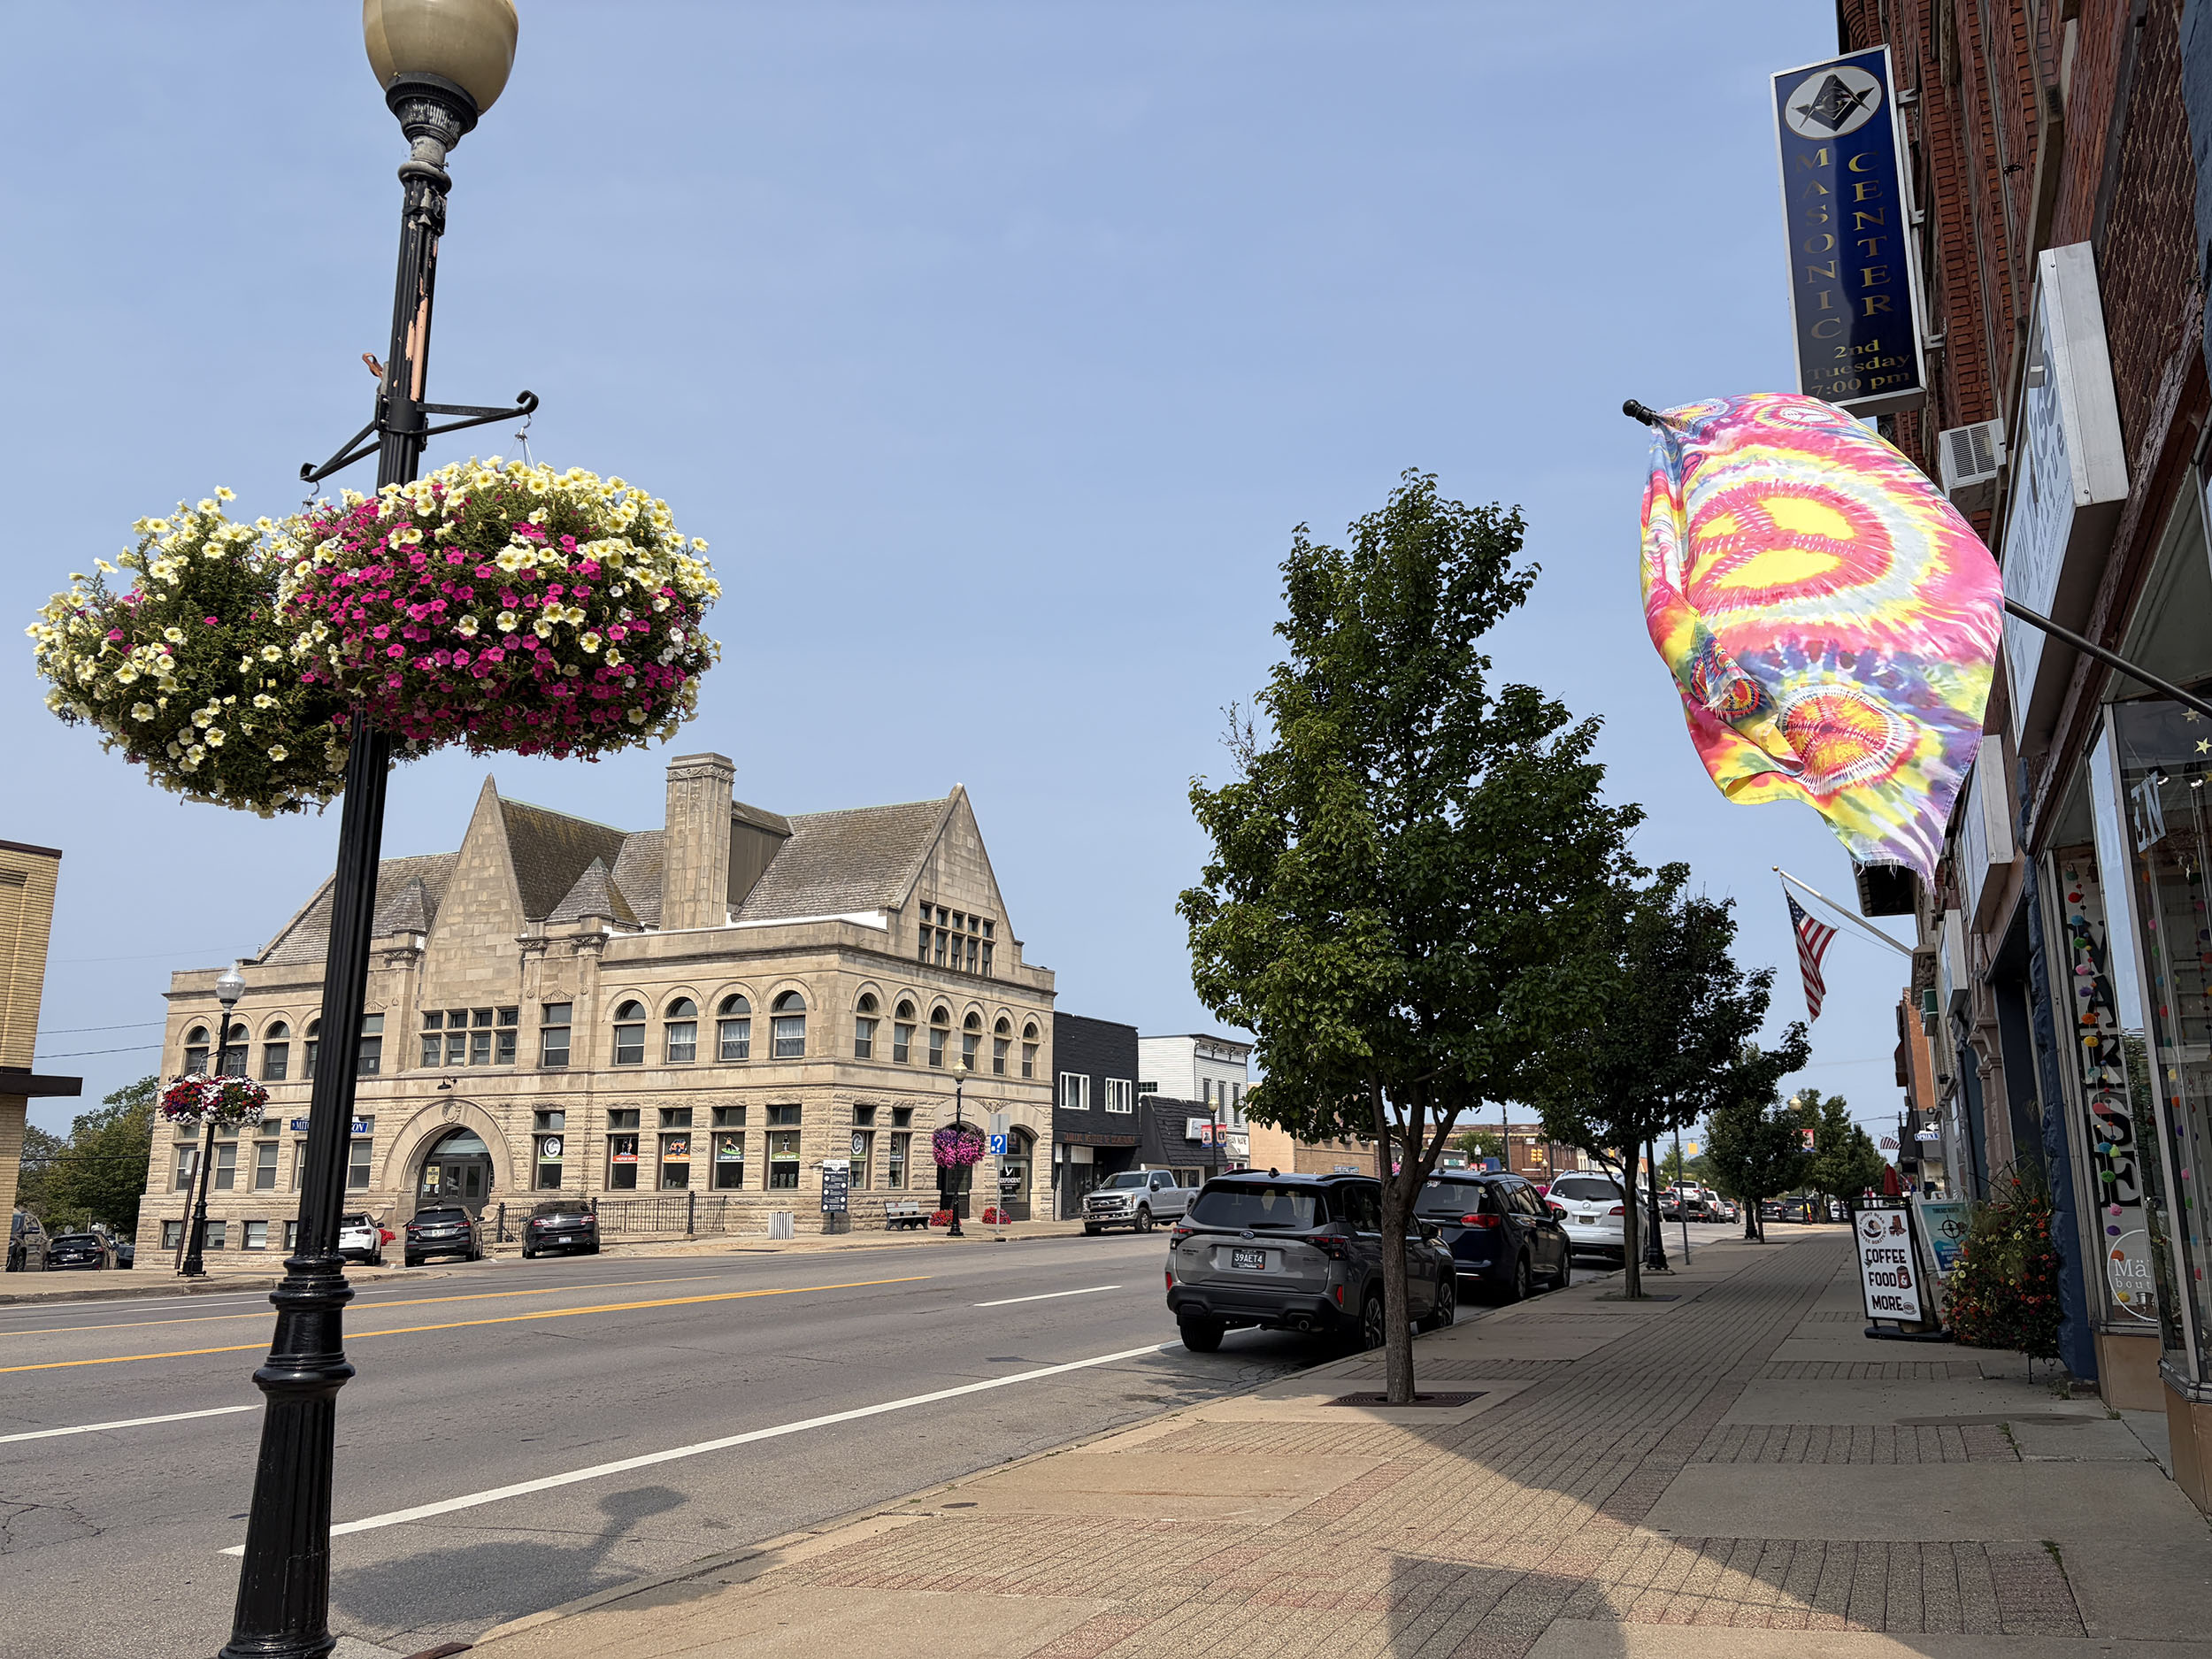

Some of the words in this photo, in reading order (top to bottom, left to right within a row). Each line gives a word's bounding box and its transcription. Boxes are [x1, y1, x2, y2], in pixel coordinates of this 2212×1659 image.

[1796, 148, 1841, 339] MASONIC
[1848, 151, 1893, 316] CENTER
[1833, 339, 1881, 359] 2nd
[1806, 355, 1910, 380] Tuesday
[1810, 378, 1863, 398] 7:00
[1870, 373, 1911, 390] pm
[1233, 1253, 1263, 1263] 39AET4
[1865, 1248, 1907, 1264] COFFEE
[2113, 1258, 2151, 1278] Mä
[1868, 1271, 1898, 1286] FOOD
[1871, 1294, 1904, 1311] MORE
